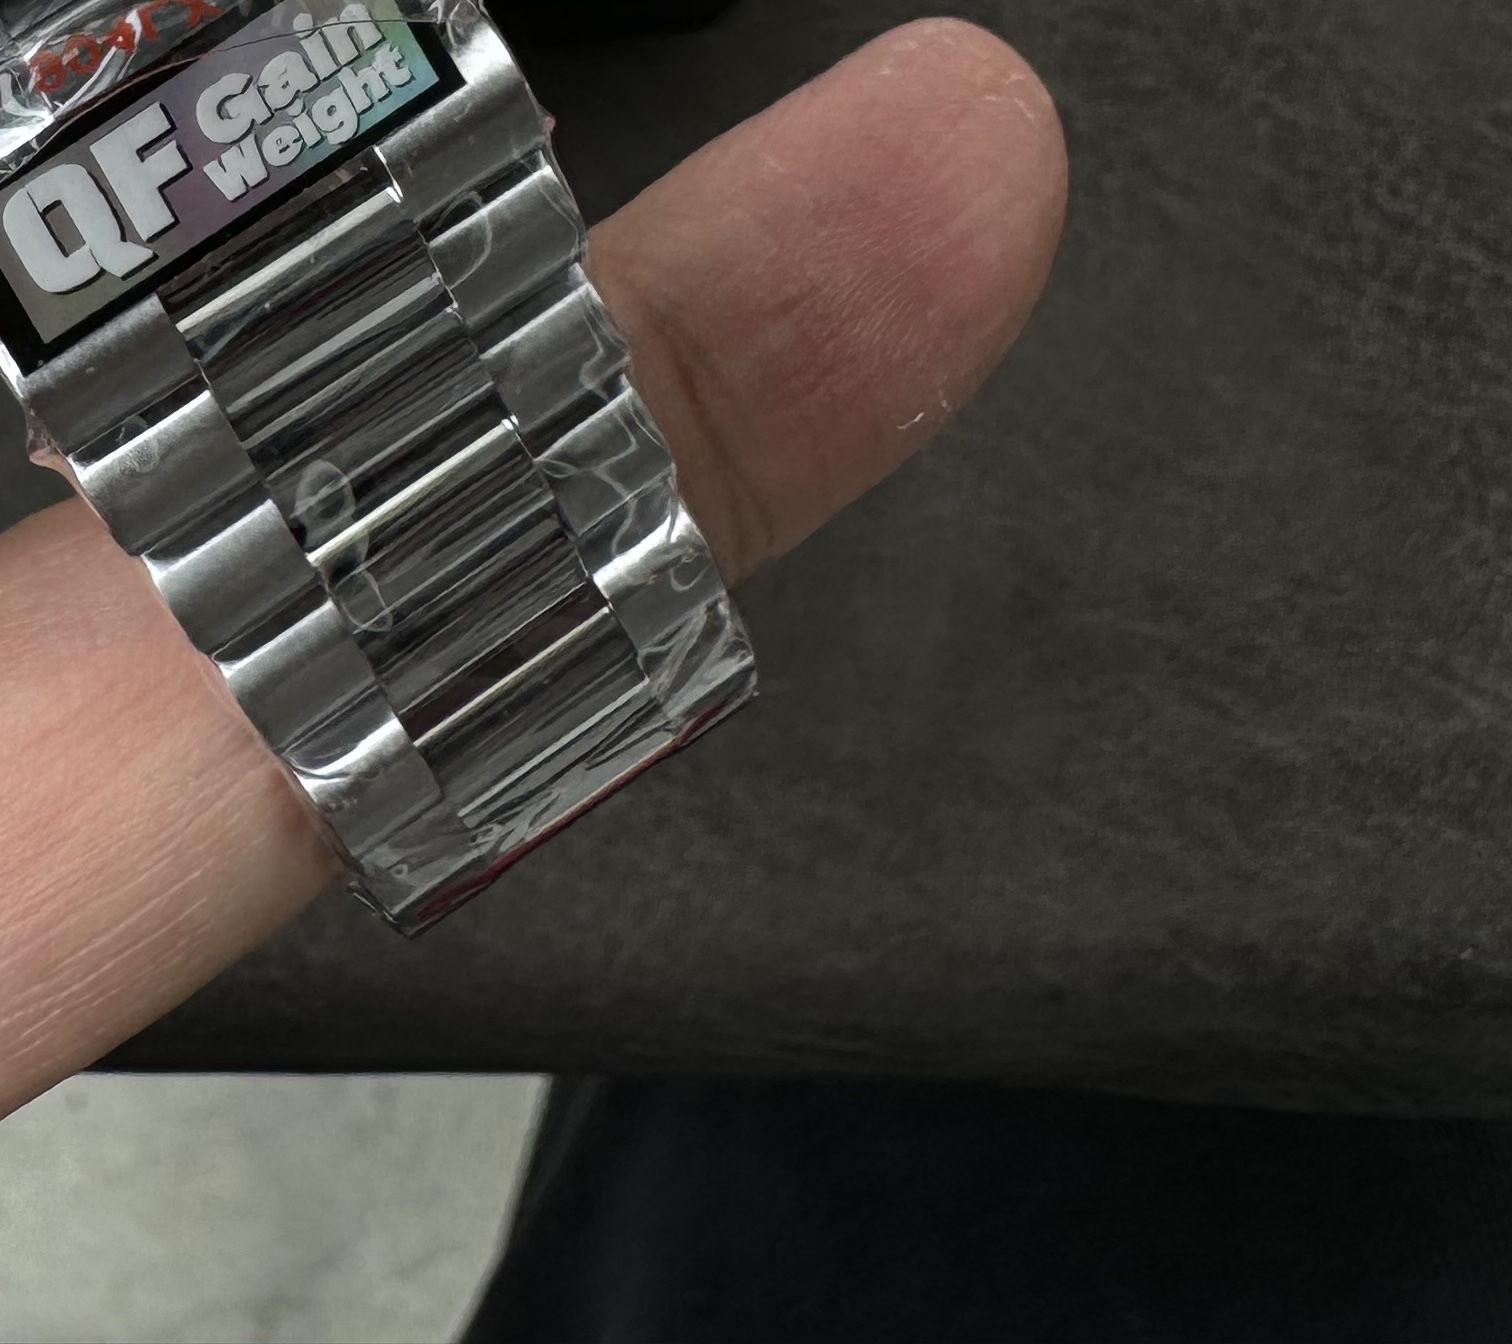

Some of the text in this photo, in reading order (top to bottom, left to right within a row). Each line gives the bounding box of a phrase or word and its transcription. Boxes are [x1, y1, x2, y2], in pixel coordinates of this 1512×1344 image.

[1, 100, 194, 296] QF
[194, 2, 388, 146] Gain
[202, 43, 416, 204] Weight
